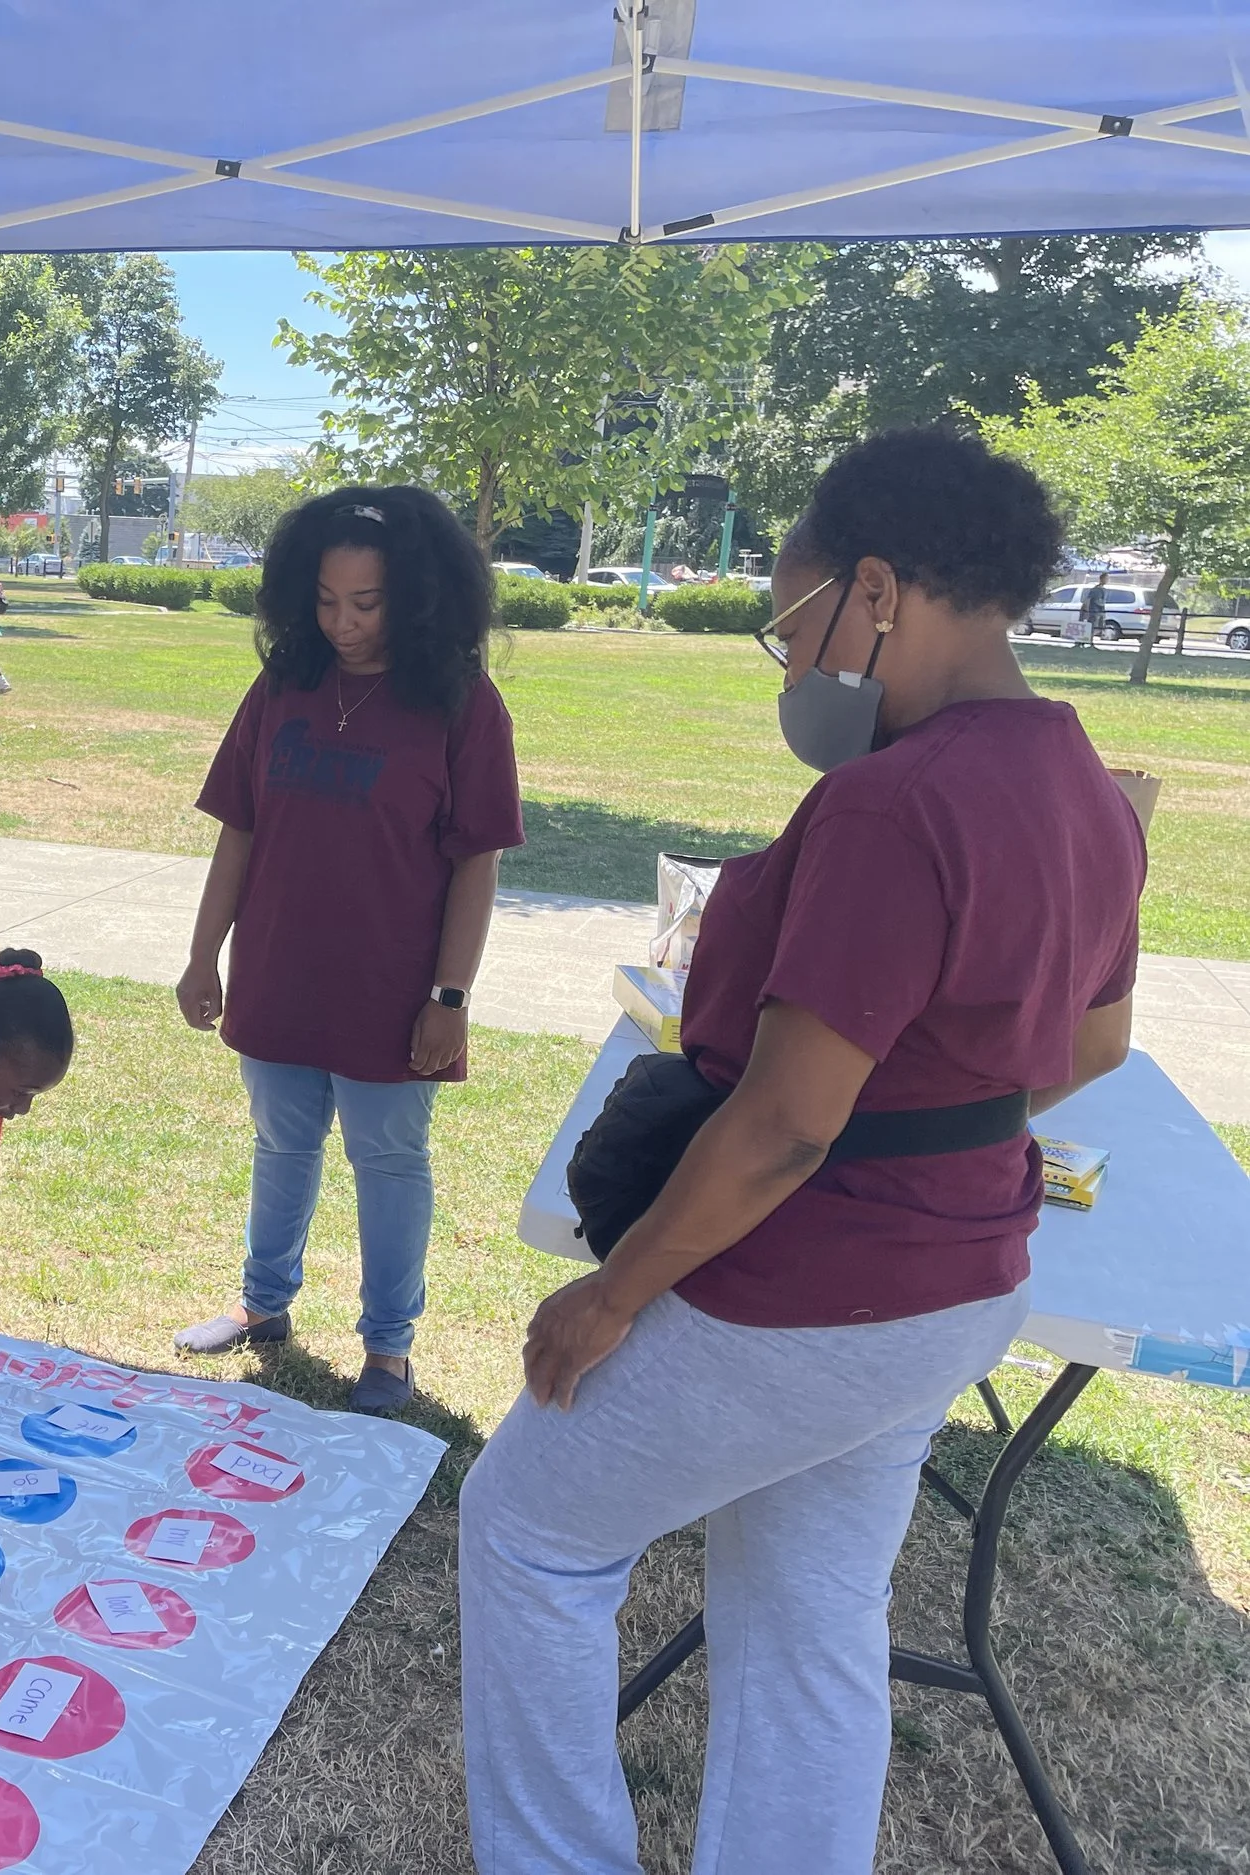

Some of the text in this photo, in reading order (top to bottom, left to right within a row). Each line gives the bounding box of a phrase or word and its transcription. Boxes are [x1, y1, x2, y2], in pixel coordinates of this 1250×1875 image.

[13, 1473, 39, 1486] go
[230, 1456, 283, 1485] bad
[155, 1527, 191, 1547] my
[105, 1595, 137, 1618] look
